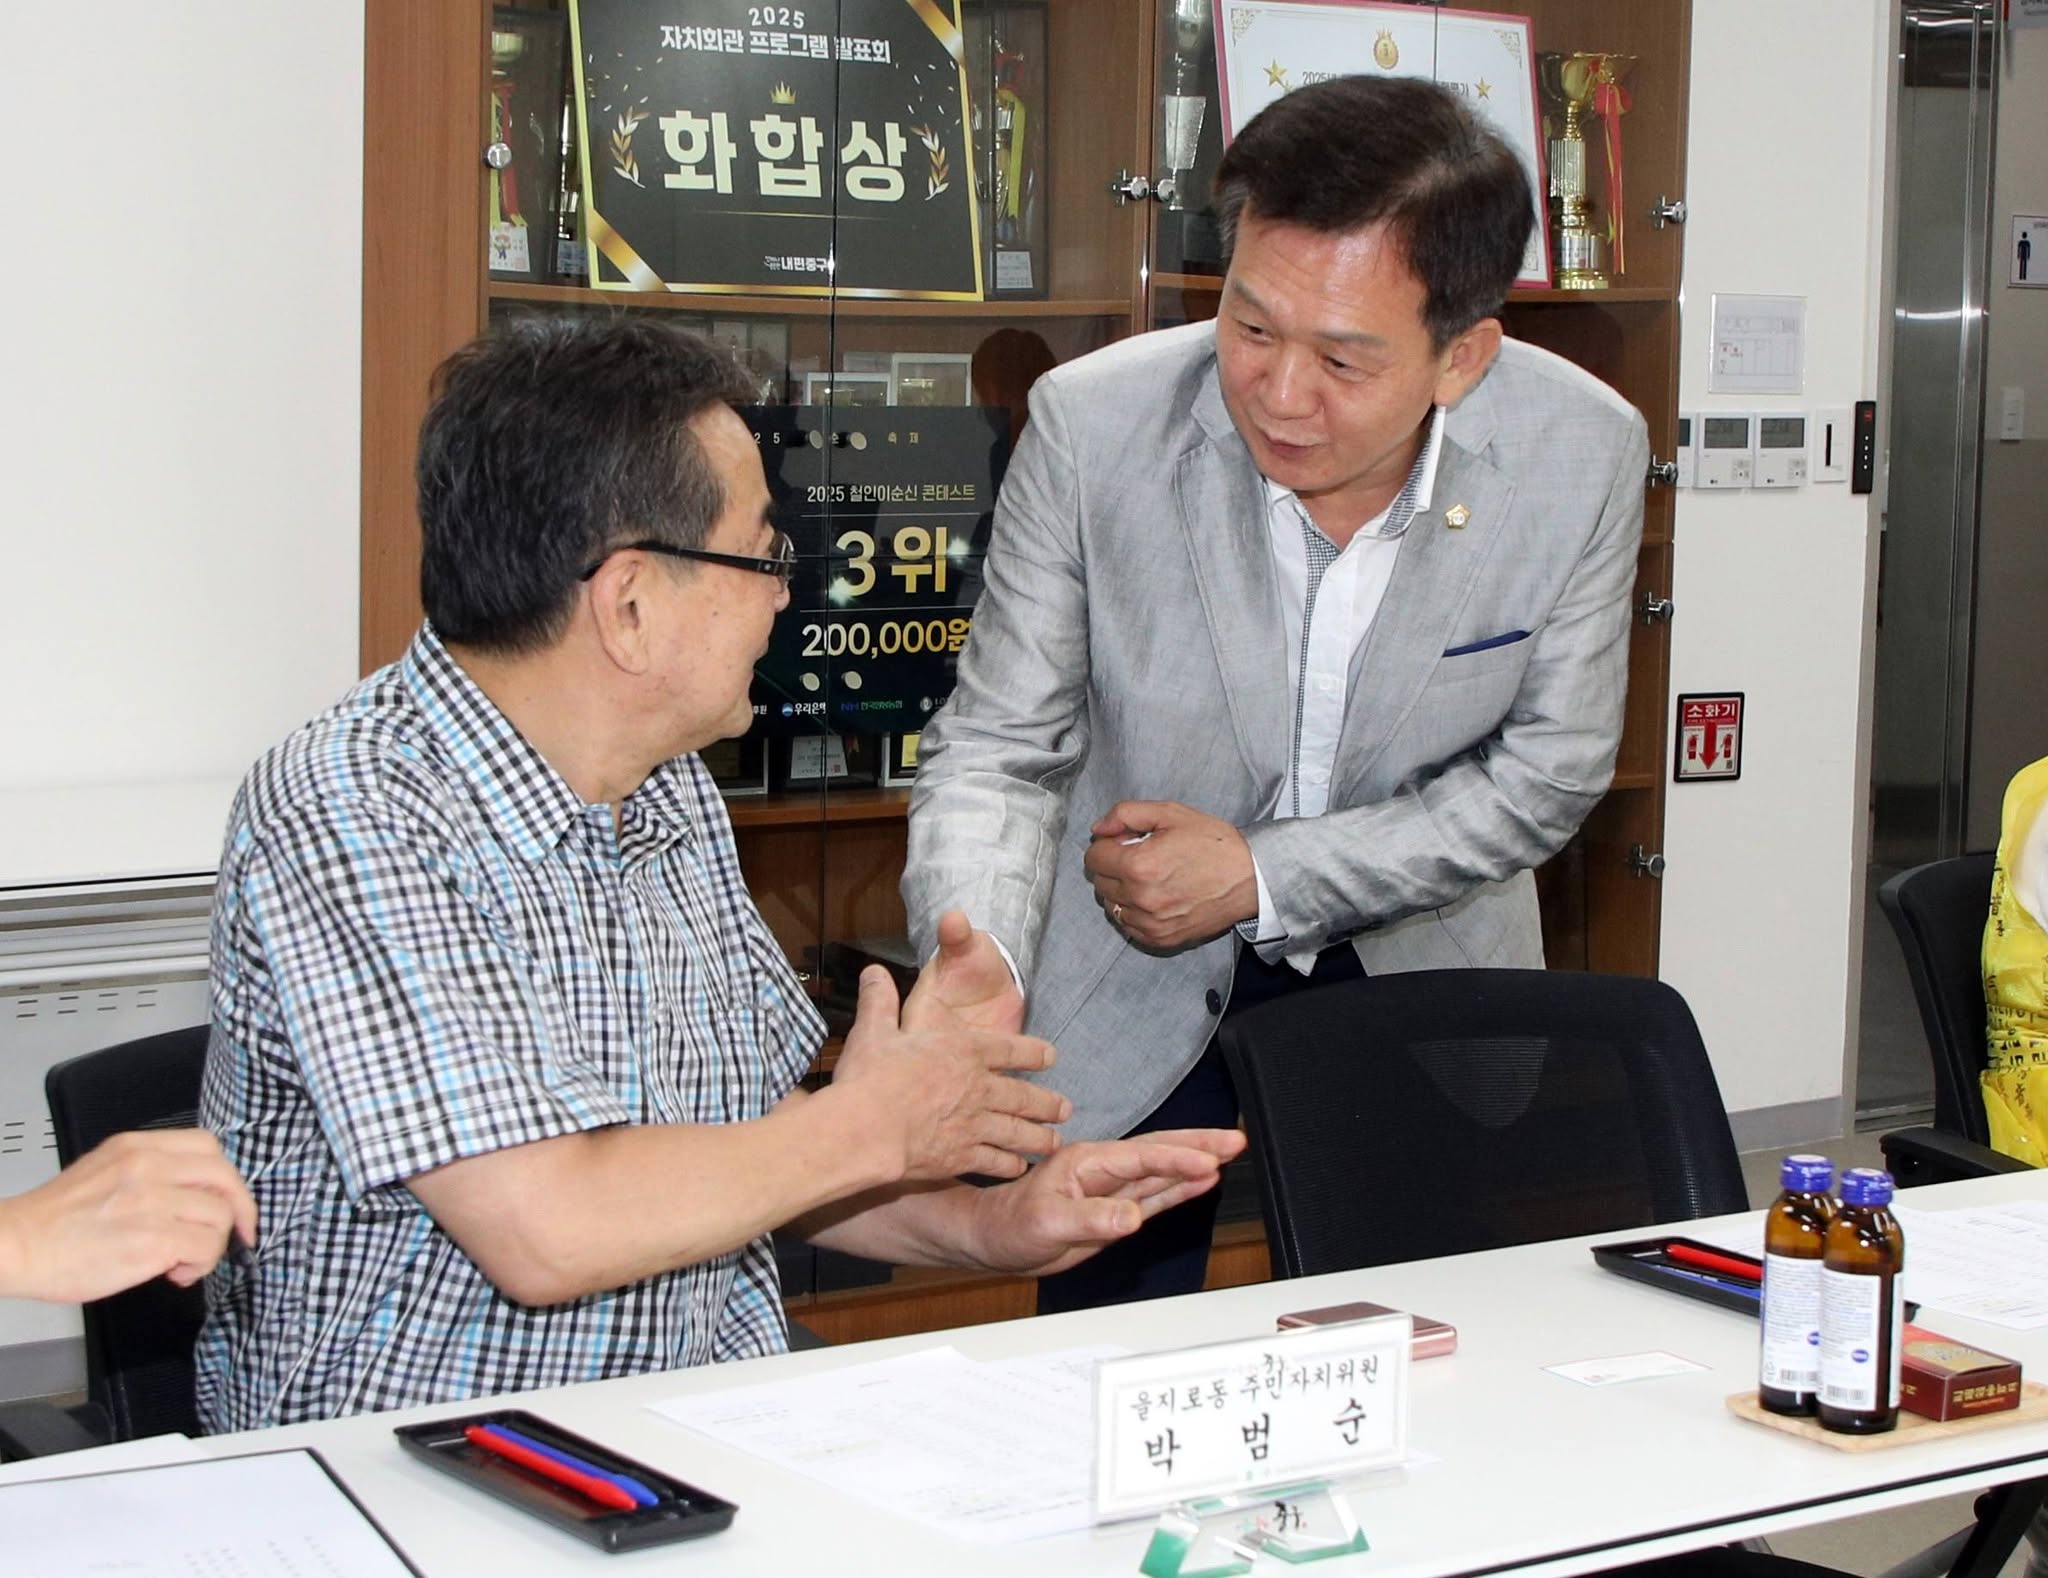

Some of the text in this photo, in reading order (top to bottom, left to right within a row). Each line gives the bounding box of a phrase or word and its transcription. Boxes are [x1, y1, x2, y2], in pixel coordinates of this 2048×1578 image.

[748, 6, 805, 29] 2025
[660, 25, 891, 64] 자치회관 프로그램 발표회
[807, 484, 976, 503] 2025 철인이순신 콘테스트
[801, 619, 972, 659] 200,000원
[1687, 703, 1735, 717] 소화기
[1130, 1379, 1229, 1421] 을지로동
[1240, 1354, 1379, 1404] 주민자치위원
